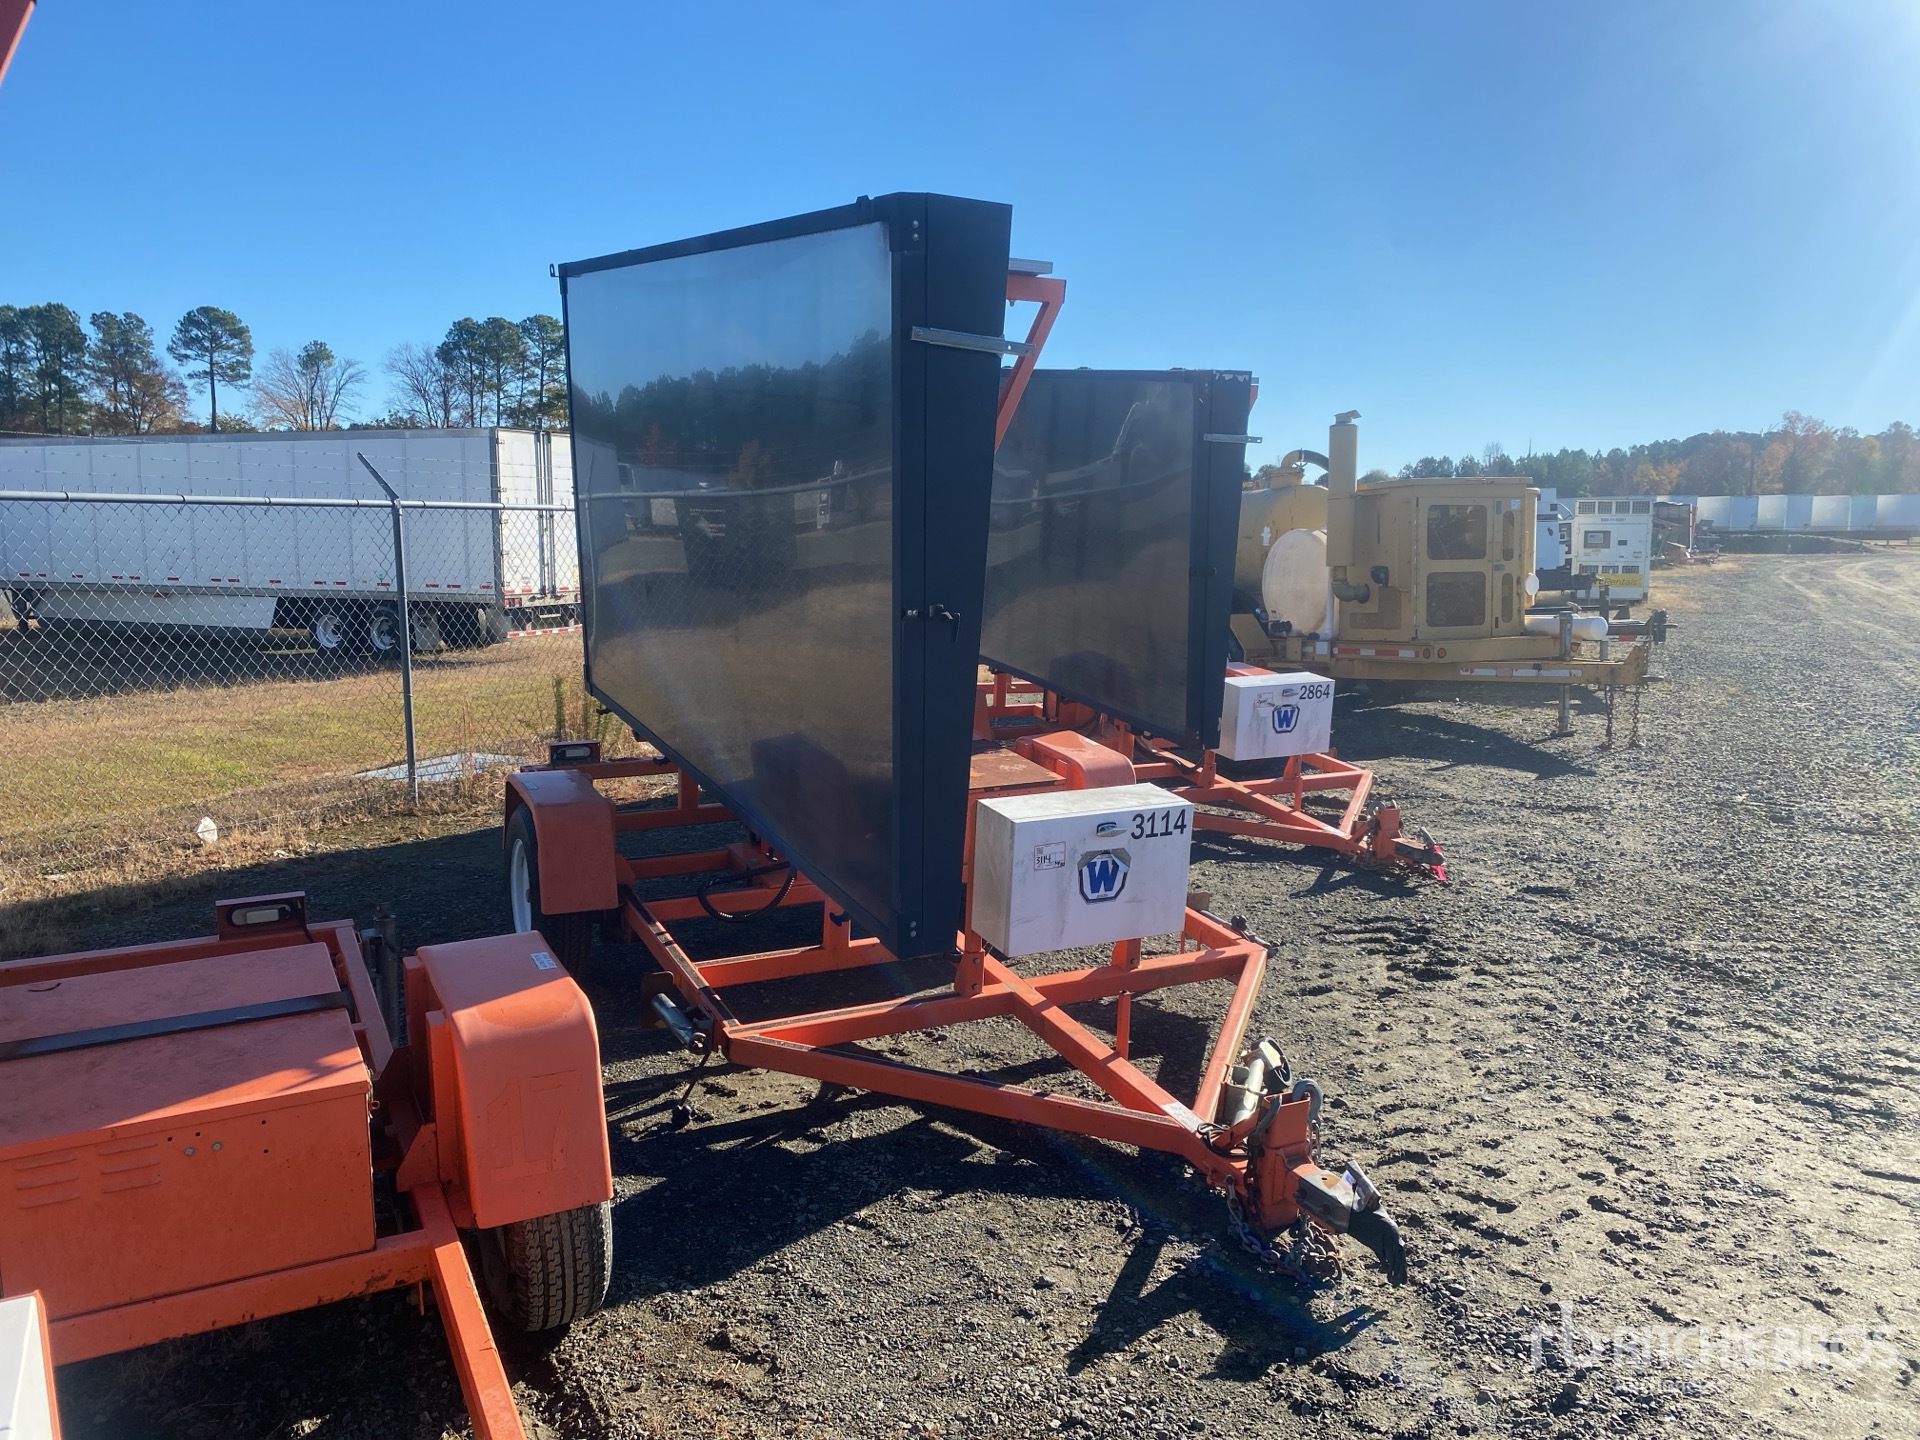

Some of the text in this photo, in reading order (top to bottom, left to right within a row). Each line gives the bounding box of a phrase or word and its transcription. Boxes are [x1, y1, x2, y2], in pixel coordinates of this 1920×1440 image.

[1299, 684, 1331, 700] 2864
[1277, 707, 1296, 729] W
[1131, 809, 1187, 840] 3114
[1036, 854, 1051, 865] 3114
[1087, 859, 1120, 894] W
